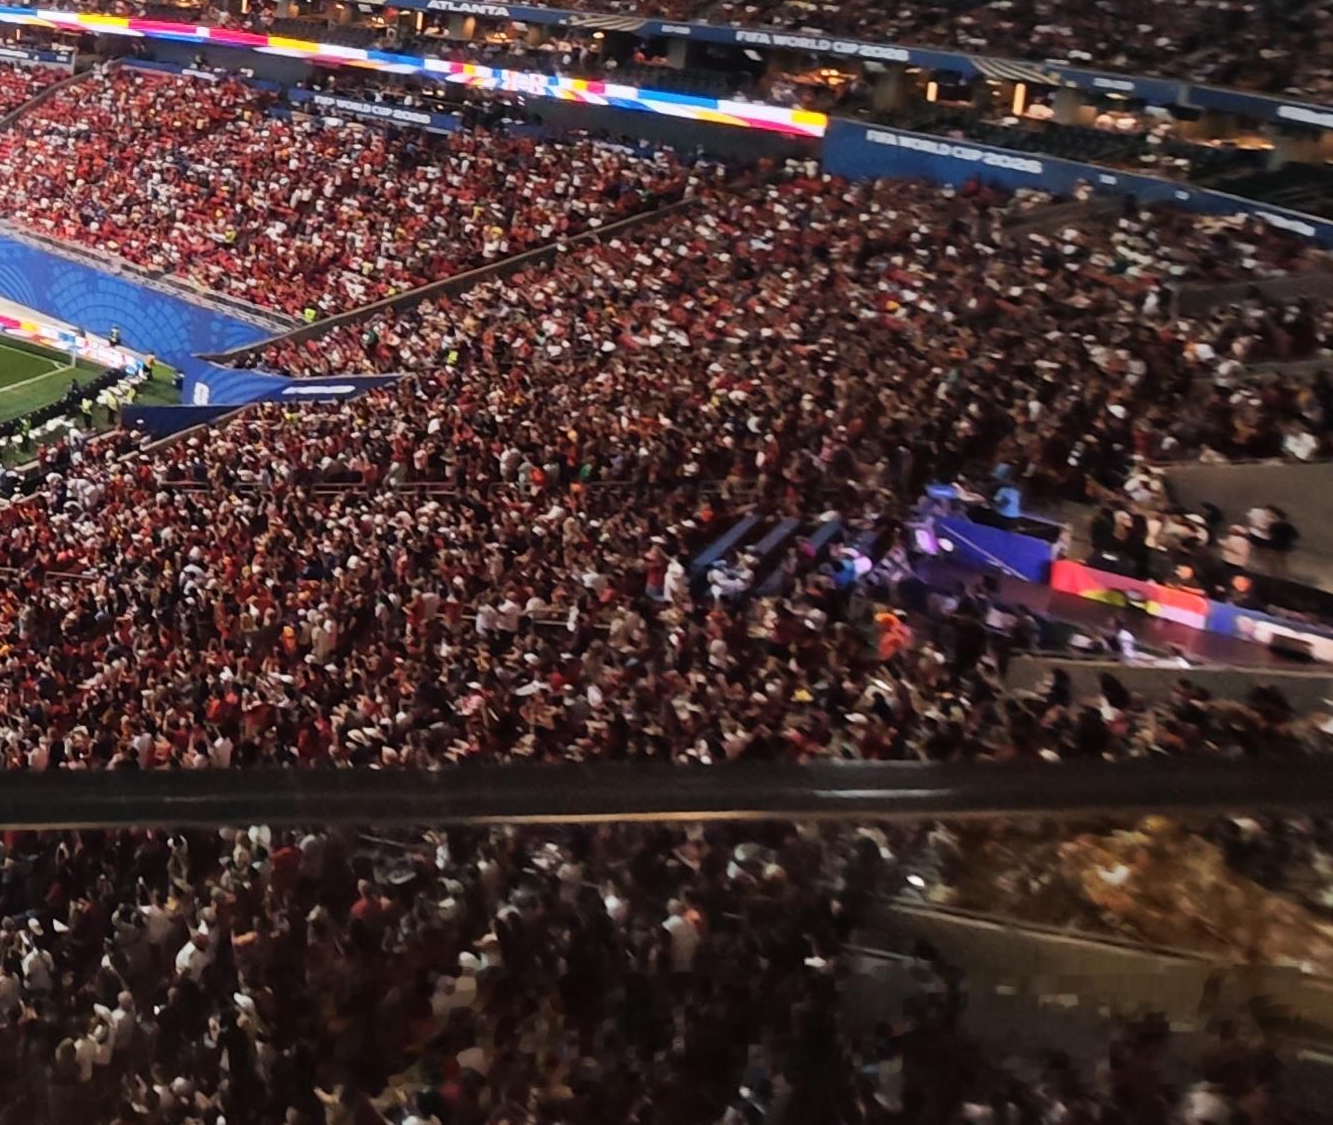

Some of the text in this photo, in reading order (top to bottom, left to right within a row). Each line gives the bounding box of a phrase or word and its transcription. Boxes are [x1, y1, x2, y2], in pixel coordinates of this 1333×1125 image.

[427, 0, 510, 16] ATLANTA
[736, 31, 771, 44] FIFA
[772, 34, 832, 51] WORLD
[832, 41, 859, 54] CUP
[336, 99, 371, 113] WORLD
[866, 129, 898, 146] FIFA
[898, 136, 951, 156] WORLD
[951, 146, 983, 161] CUP
